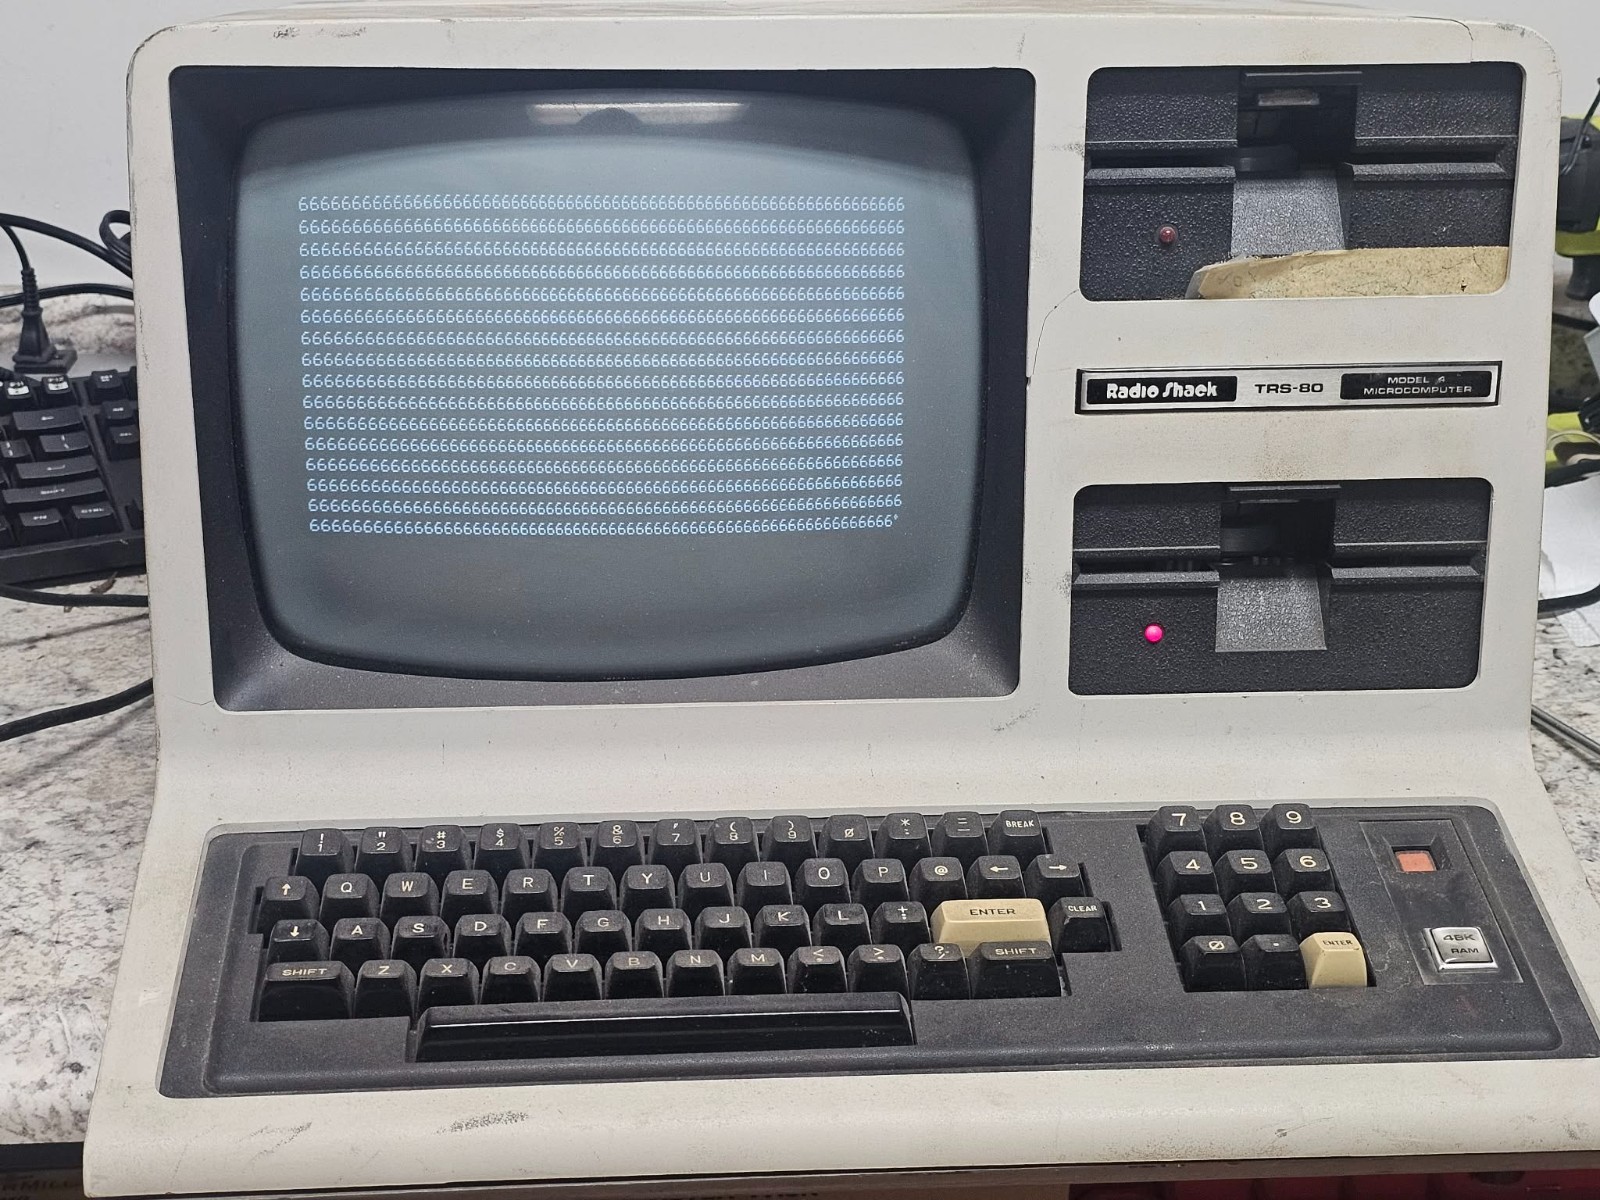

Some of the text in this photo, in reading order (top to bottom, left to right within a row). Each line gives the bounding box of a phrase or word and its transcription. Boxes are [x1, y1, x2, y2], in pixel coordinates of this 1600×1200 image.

[1387, 376, 1430, 384] MODEL
[1107, 382, 1218, 399] Radio Shack
[1255, 383, 1324, 394] TRS-80
[1363, 385, 1472, 396] MICROCOMPUTER
[1172, 813, 1186, 826] 7
[1230, 812, 1245, 825] 8
[1286, 811, 1301, 823] 9
[554, 827, 564, 836] %
[613, 825, 623, 834] &
[555, 837, 563, 845] 5
[613, 836, 621, 844] 6
[672, 834, 680, 842] 7
[377, 842, 385, 850] 2
[1186, 859, 1200, 870] 4
[1241, 858, 1257, 869] 5
[1300, 856, 1316, 867] 6
[819, 867, 830, 879] O
[879, 867, 888, 877] P
[935, 866, 948, 875] @
[523, 877, 533, 887] R
[583, 875, 594, 885] T
[642, 873, 652, 884] Y
[700, 872, 710, 882] U
[341, 882, 352, 892] Q
[402, 881, 413, 891] W
[463, 879, 473, 889] E
[1067, 904, 1097, 912] CLEAR
[1198, 901, 1206, 910] 1
[1257, 899, 1272, 909] 2
[1315, 898, 1331, 908] 3
[719, 914, 730, 923] J
[777, 911, 790, 921] K
[838, 910, 849, 920] L
[537, 919, 548, 928] F
[598, 918, 609, 927] G
[658, 916, 669, 925] H
[352, 925, 362, 934] A
[413, 923, 424, 933] S
[475, 922, 487, 931] D
[751, 954, 765, 962] M
[442, 965, 452, 973] X
[505, 962, 516, 970] C
[567, 960, 578, 968] V
[378, 966, 389, 974] Z
